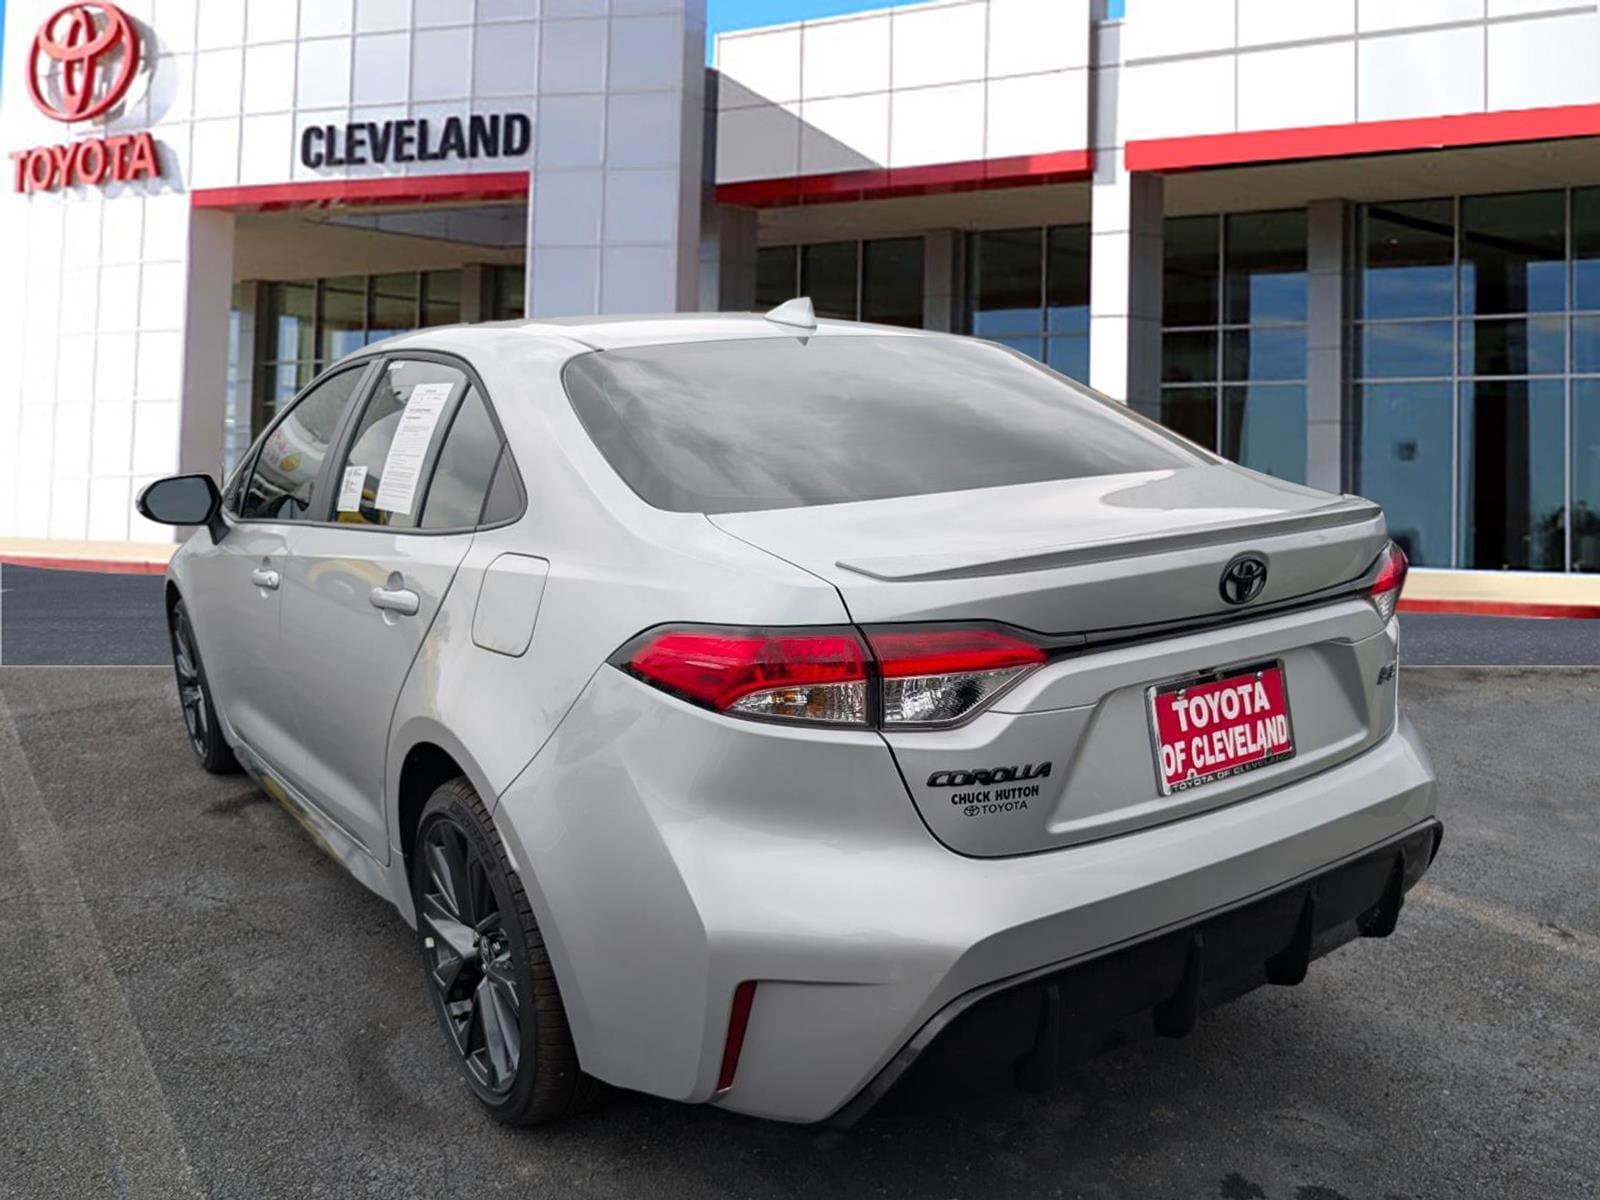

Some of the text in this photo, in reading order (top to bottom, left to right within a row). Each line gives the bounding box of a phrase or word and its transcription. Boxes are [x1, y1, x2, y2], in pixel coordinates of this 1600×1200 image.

[301, 113, 531, 170] CLEVELAND
[9, 132, 161, 193] TOYOTA
[1172, 681, 1271, 732] TOYOTA
[1162, 714, 1289, 777] OF CLEVELAND
[926, 761, 1053, 787] COROLLA
[1173, 776, 1214, 792] TOYOTA
[1217, 770, 1231, 780] OF
[951, 785, 1040, 805] CHUCK HUTTON
[982, 800, 1028, 814] TOYOTA
